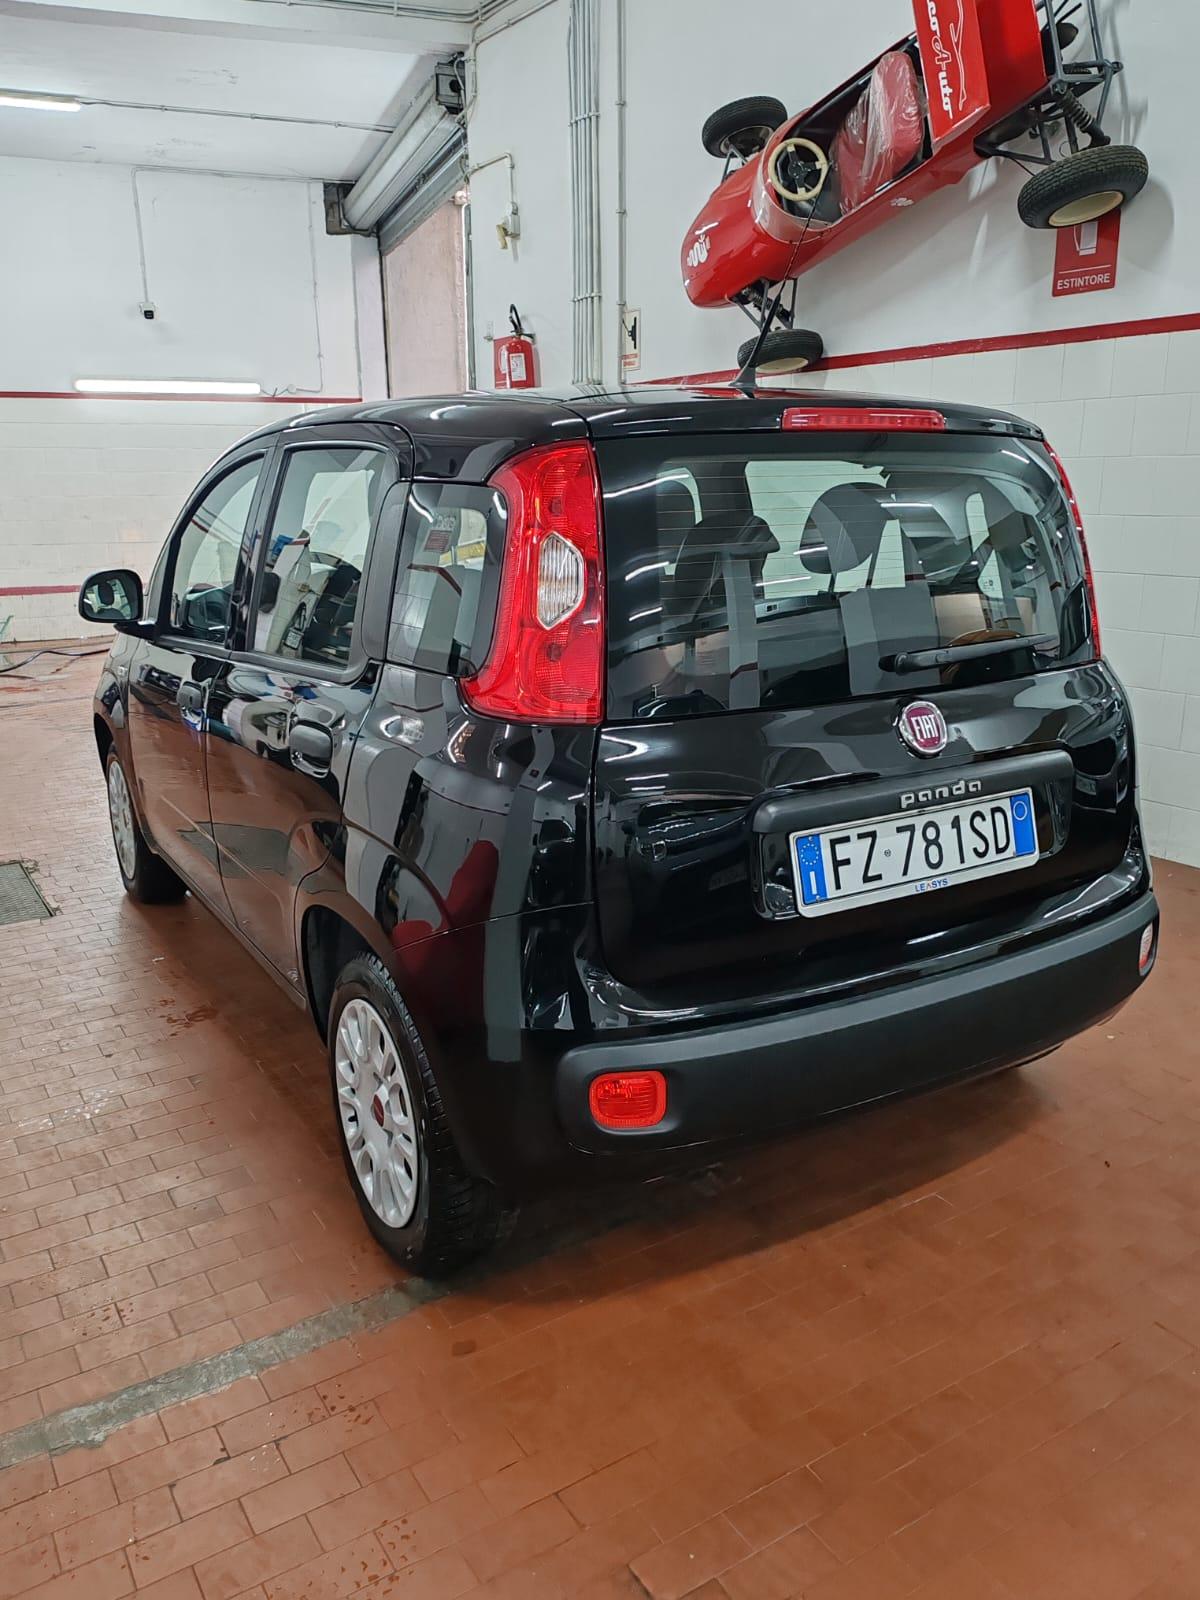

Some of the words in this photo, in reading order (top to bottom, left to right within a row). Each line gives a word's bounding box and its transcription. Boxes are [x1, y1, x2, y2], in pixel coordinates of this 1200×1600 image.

[1057, 273, 1111, 290] ESTINTORE
[911, 714, 939, 740] FIAT
[901, 780, 981, 809] panda
[914, 878, 949, 893] LEASYS
